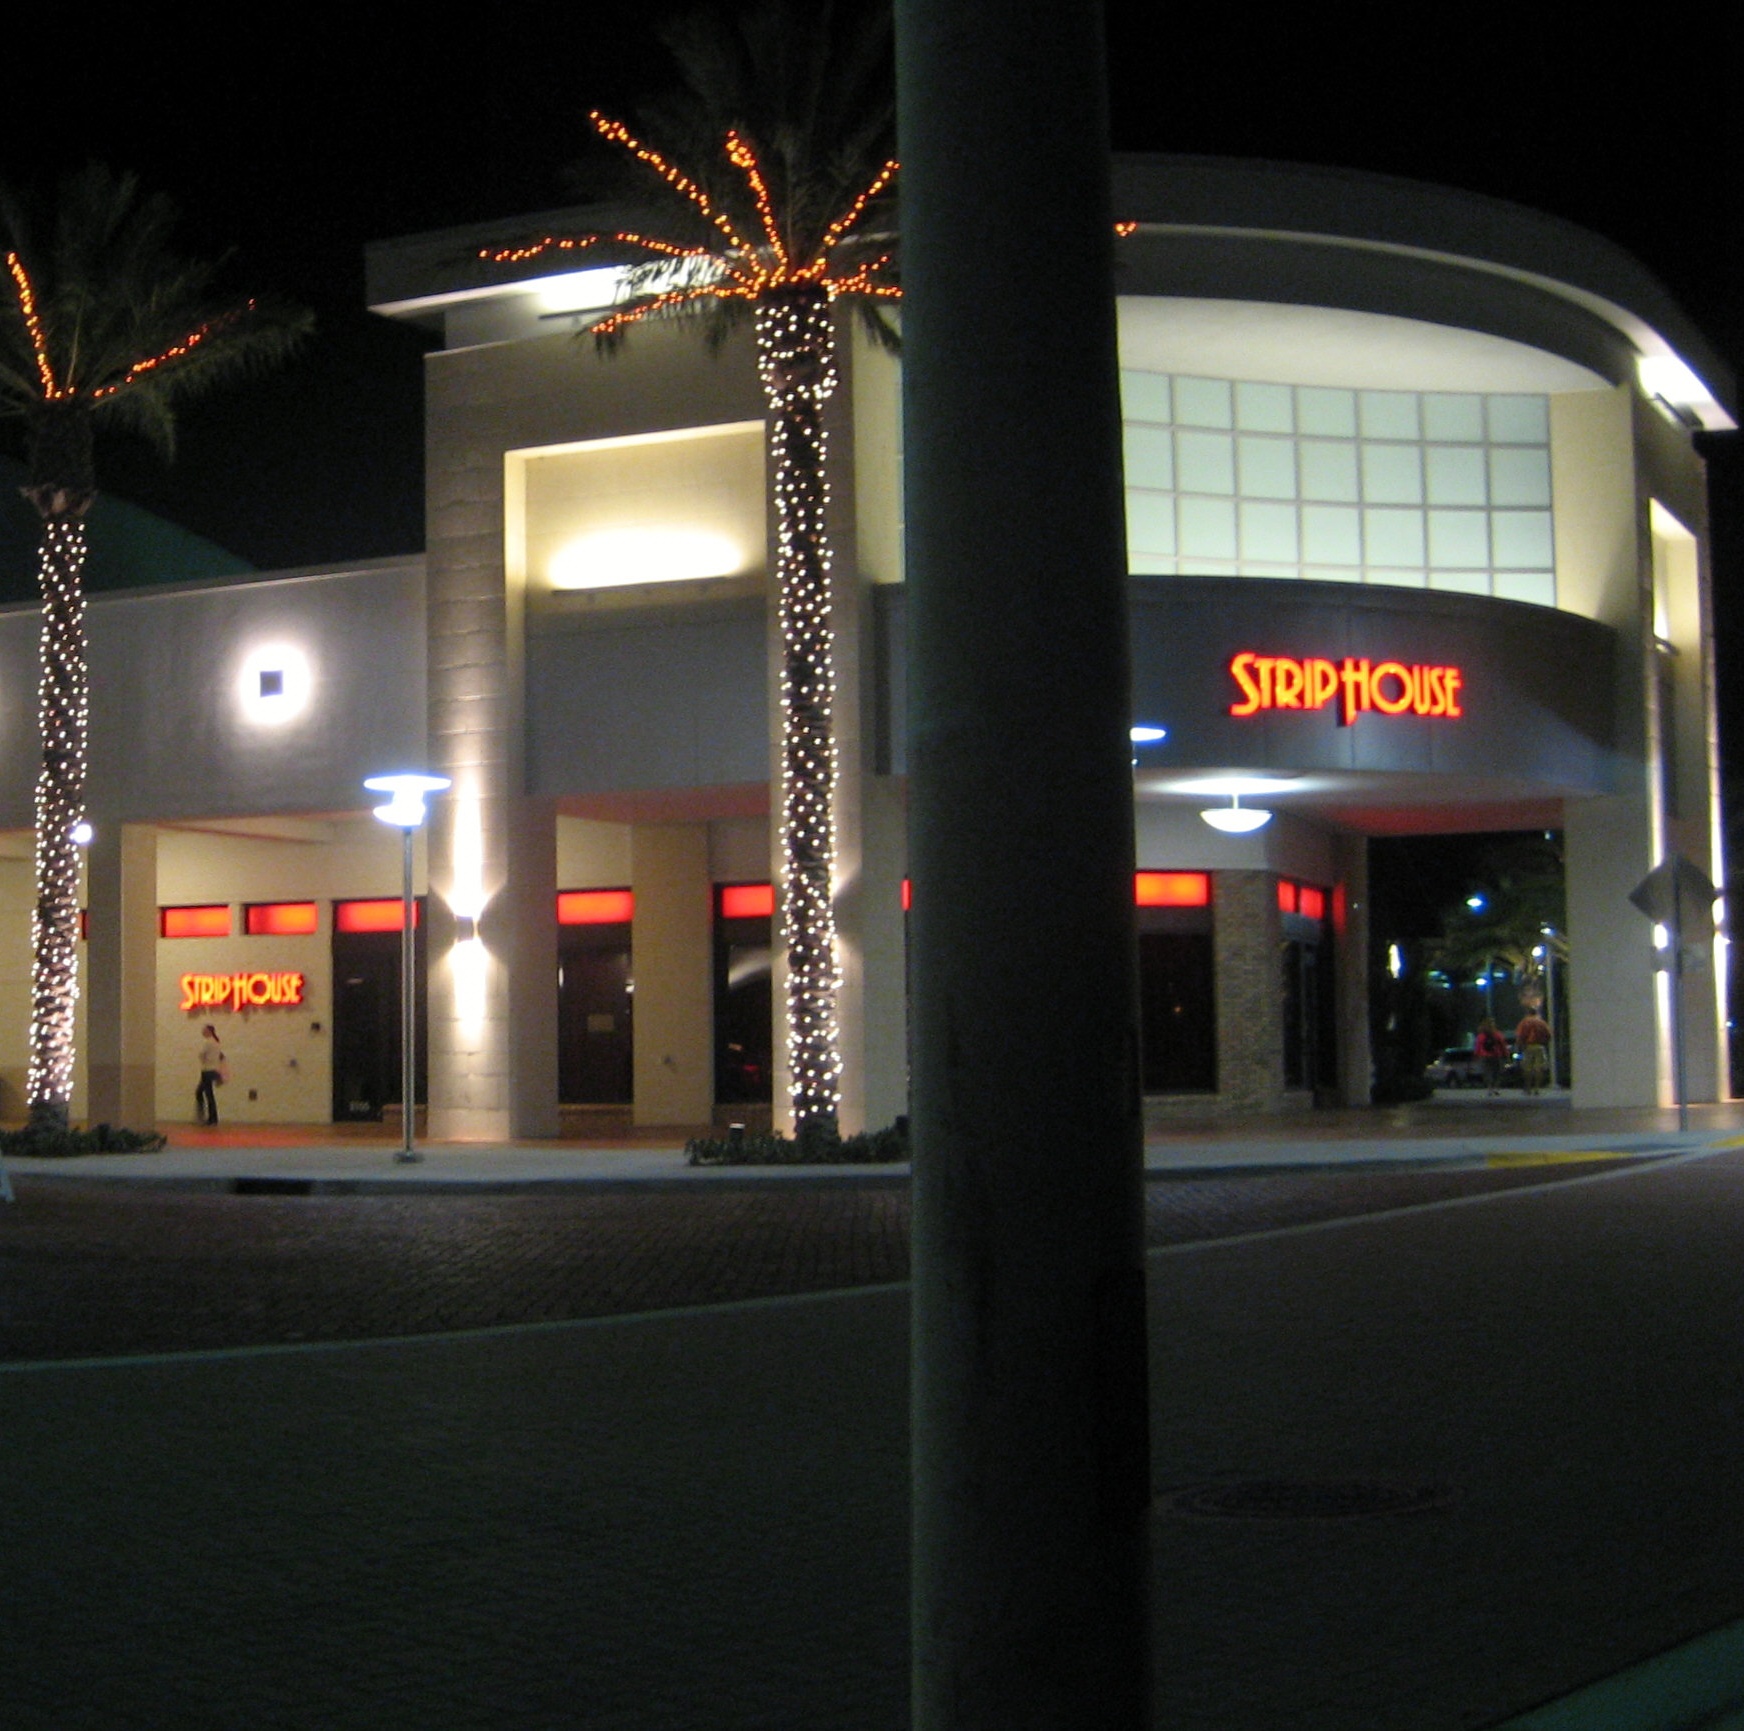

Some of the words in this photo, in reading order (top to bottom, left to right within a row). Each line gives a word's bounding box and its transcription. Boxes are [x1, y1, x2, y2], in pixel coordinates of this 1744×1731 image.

[1230, 653, 1339, 717] STRIP
[1340, 657, 1463, 726] HOUSE
[180, 973, 233, 1011] STRIP
[233, 973, 304, 1012] HOUSE
